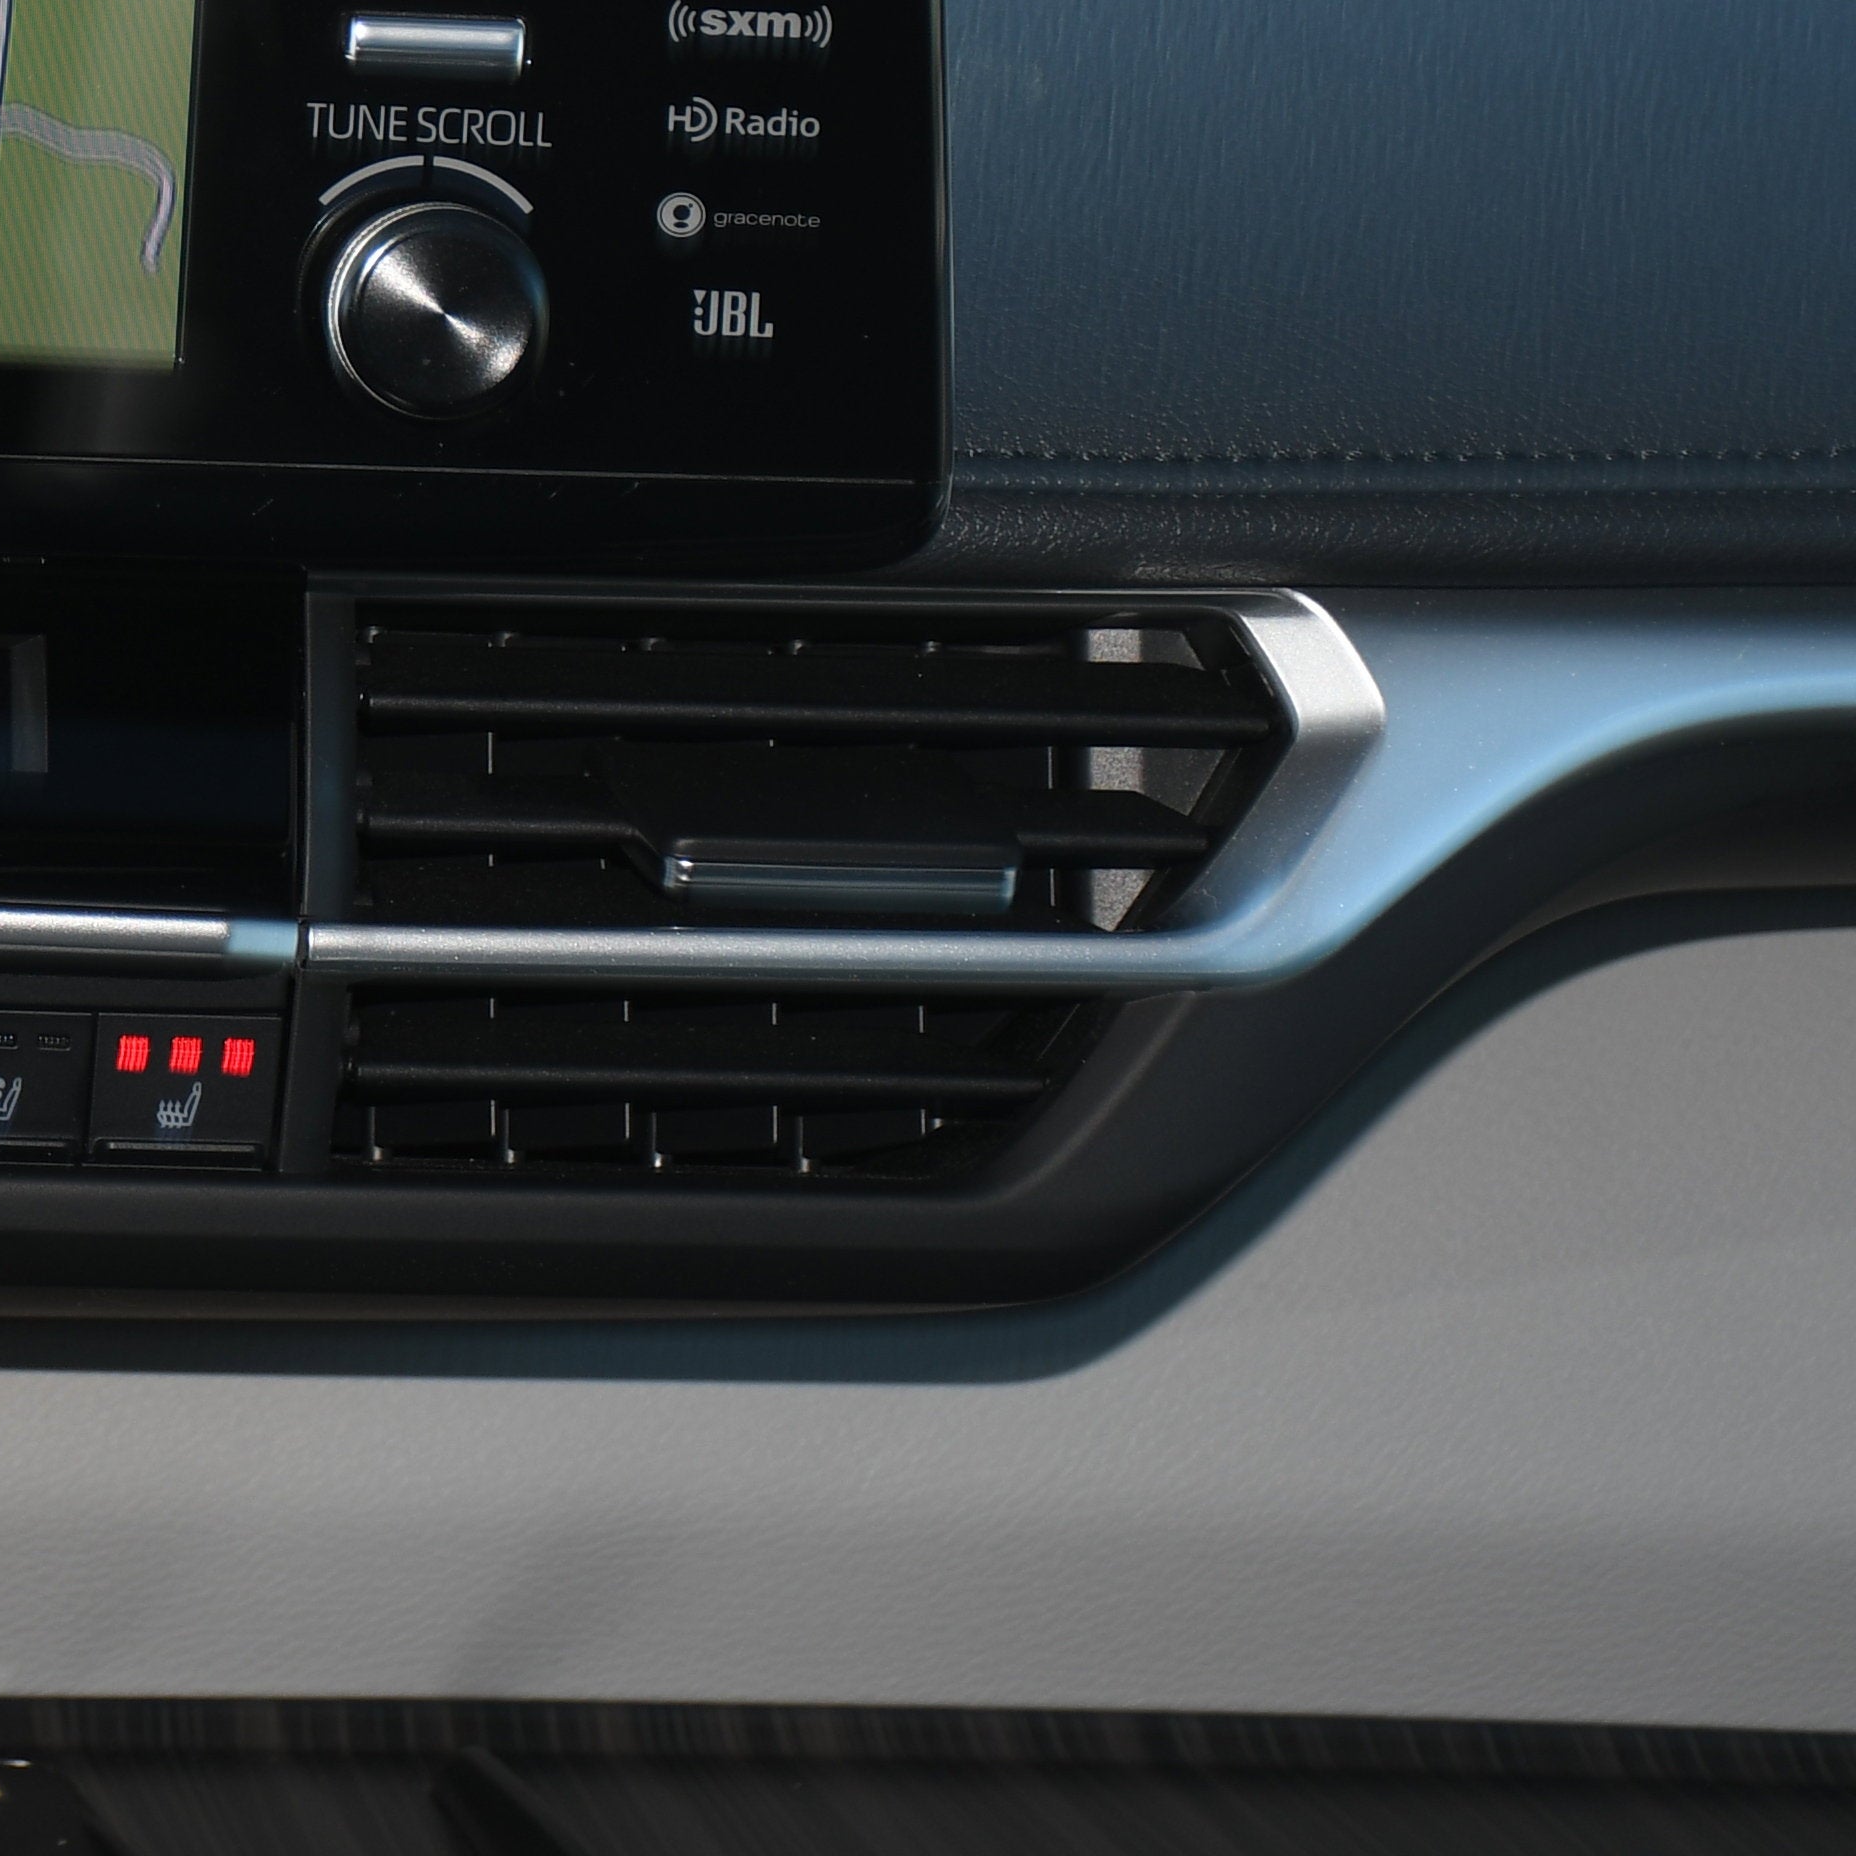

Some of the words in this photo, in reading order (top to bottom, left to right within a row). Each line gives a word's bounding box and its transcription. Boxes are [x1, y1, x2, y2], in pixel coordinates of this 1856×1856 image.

[306, 101, 409, 143] TUNE
[416, 107, 553, 148] SCROLL
[723, 107, 821, 139] Radio
[713, 209, 822, 232] gracenote
[692, 288, 774, 339] JBL
